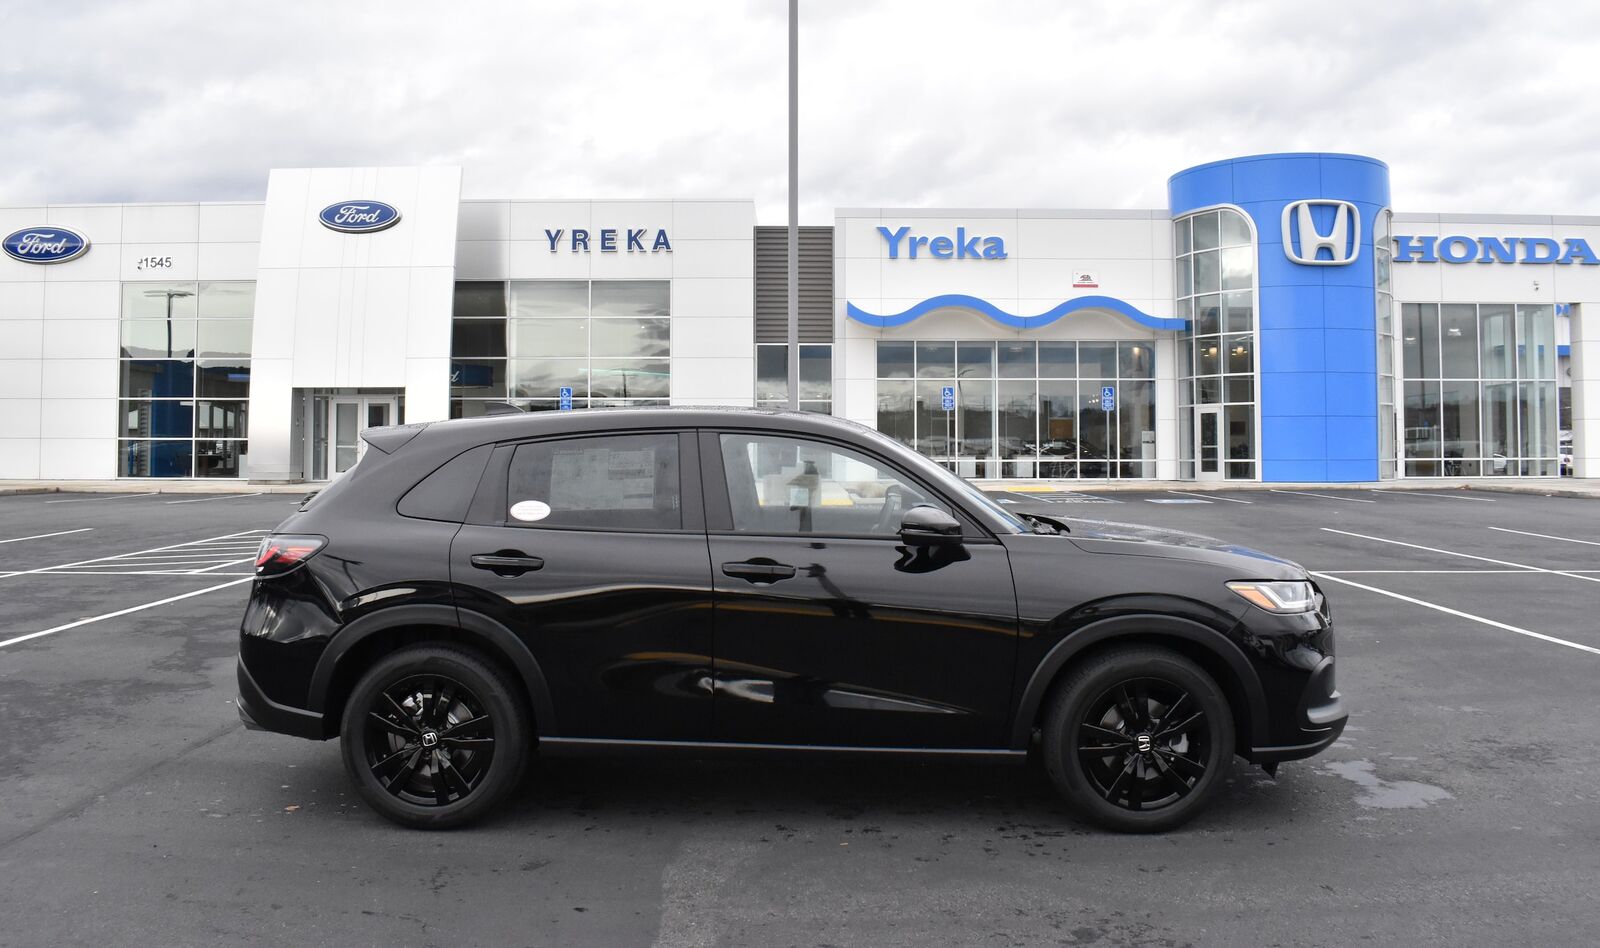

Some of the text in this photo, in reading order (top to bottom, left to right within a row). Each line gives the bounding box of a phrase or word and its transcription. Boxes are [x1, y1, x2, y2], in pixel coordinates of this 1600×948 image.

[335, 205, 381, 223] Ford
[17, 233, 67, 254] Ford
[545, 228, 673, 252] YREKA
[877, 226, 1008, 259] Yreka
[1393, 236, 1600, 264] HONDA
[144, 257, 171, 267] 1545
